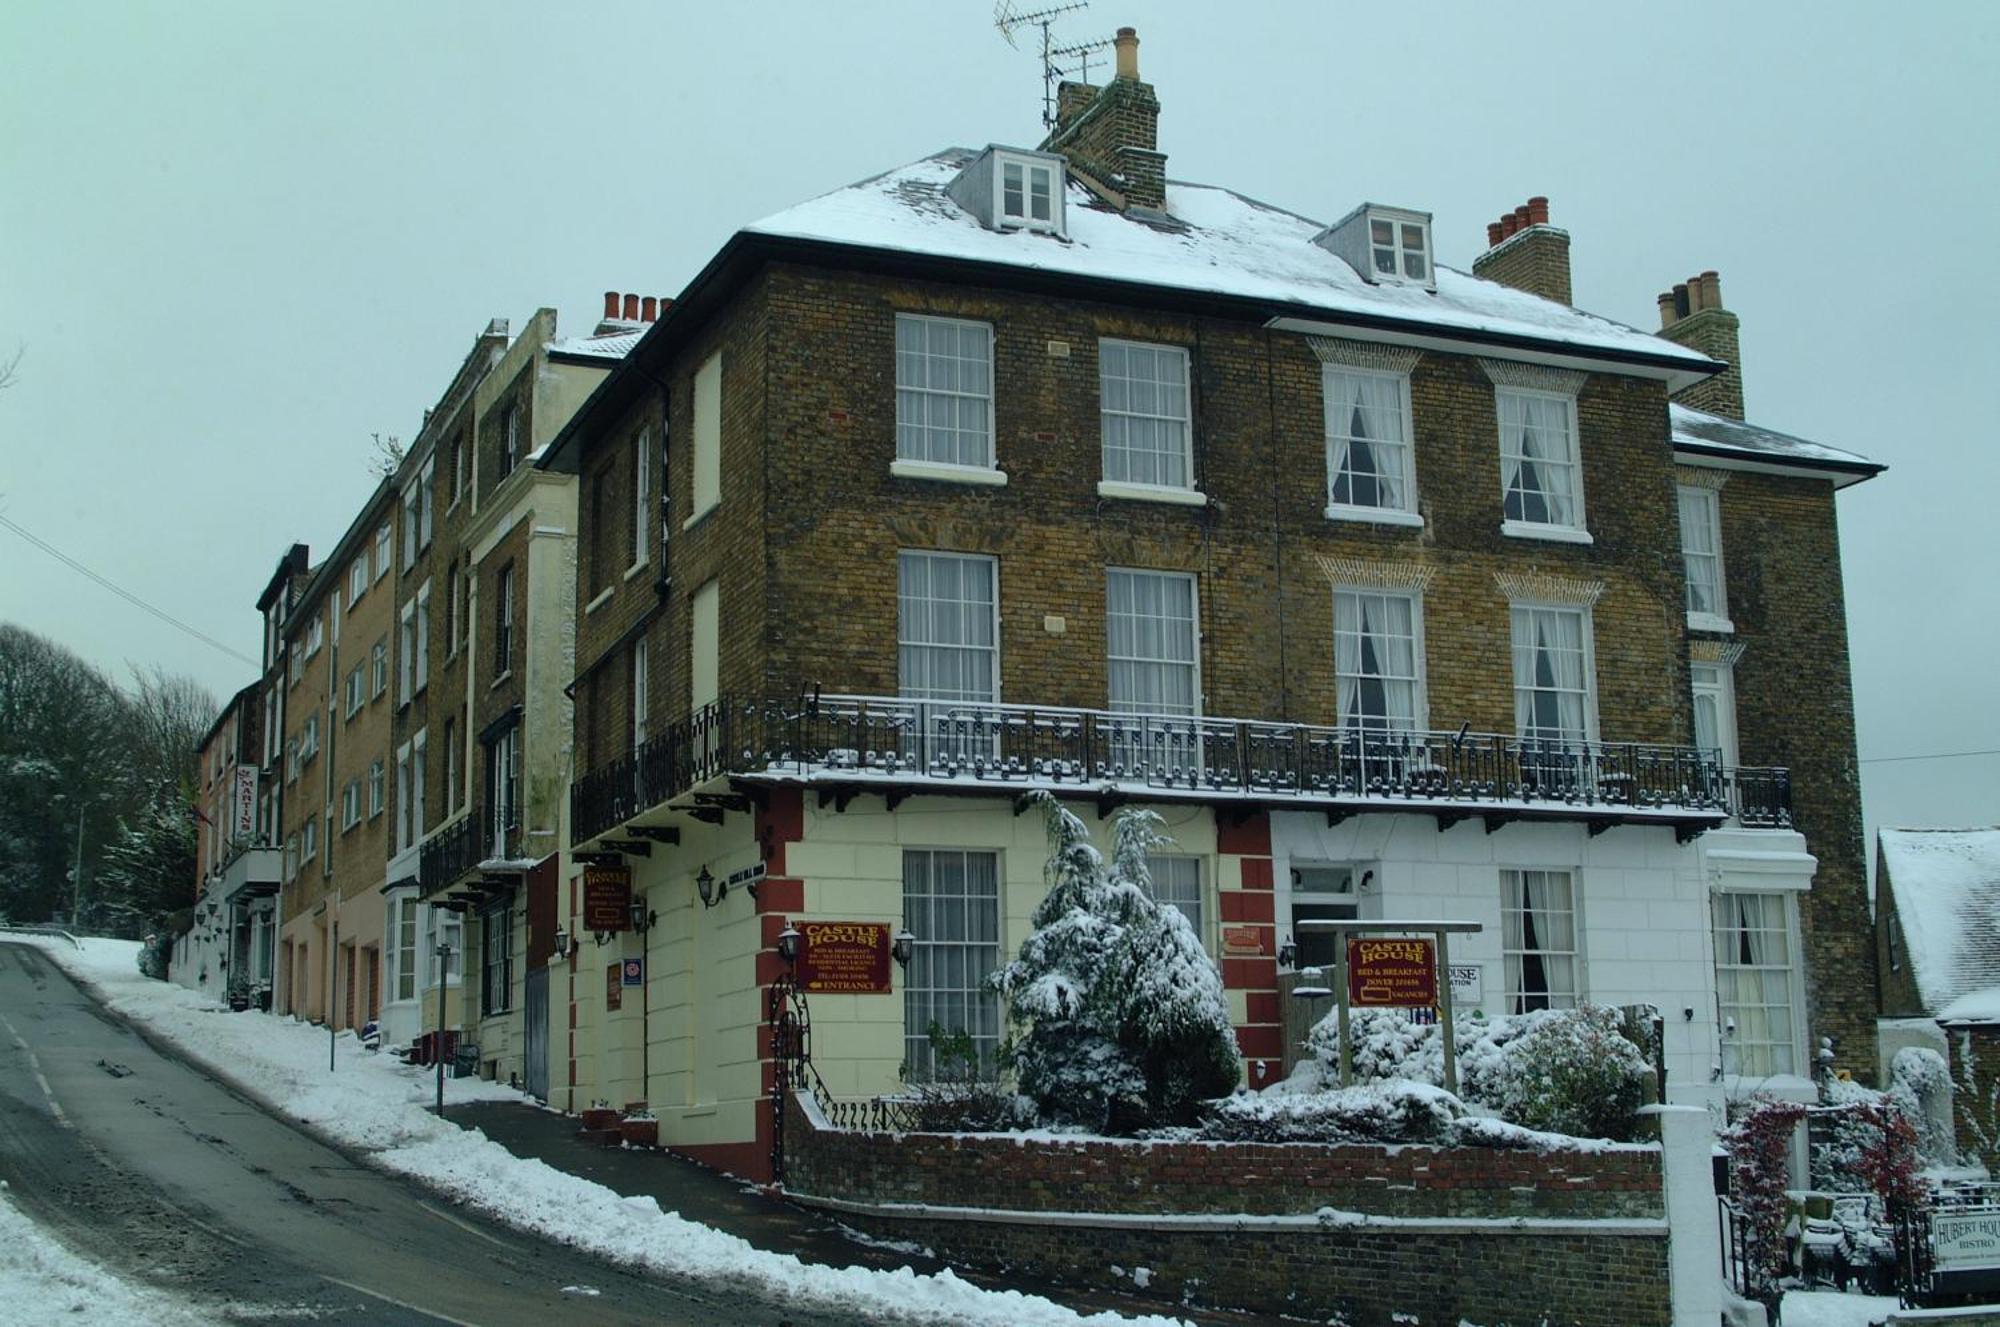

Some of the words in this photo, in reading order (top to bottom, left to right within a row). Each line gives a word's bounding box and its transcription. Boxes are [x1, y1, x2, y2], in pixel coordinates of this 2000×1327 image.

[241, 780, 254, 831] MARTINS
[806, 925, 878, 937] CASTLE
[807, 934, 878, 949] HOUSE
[1360, 942, 1424, 953] CASTLE
[1362, 951, 1424, 964] HOUSE
[1383, 968, 1427, 976] BREAKFAST
[1448, 968, 1477, 981] OUSE
[824, 981, 875, 991] ENTRANCE
[1366, 978, 1394, 986] DOVER
[1937, 1221, 1977, 1245] HUBERT
[1979, 1220, 2000, 1238] HOU
[1959, 1239, 1996, 1249] BISTRO
